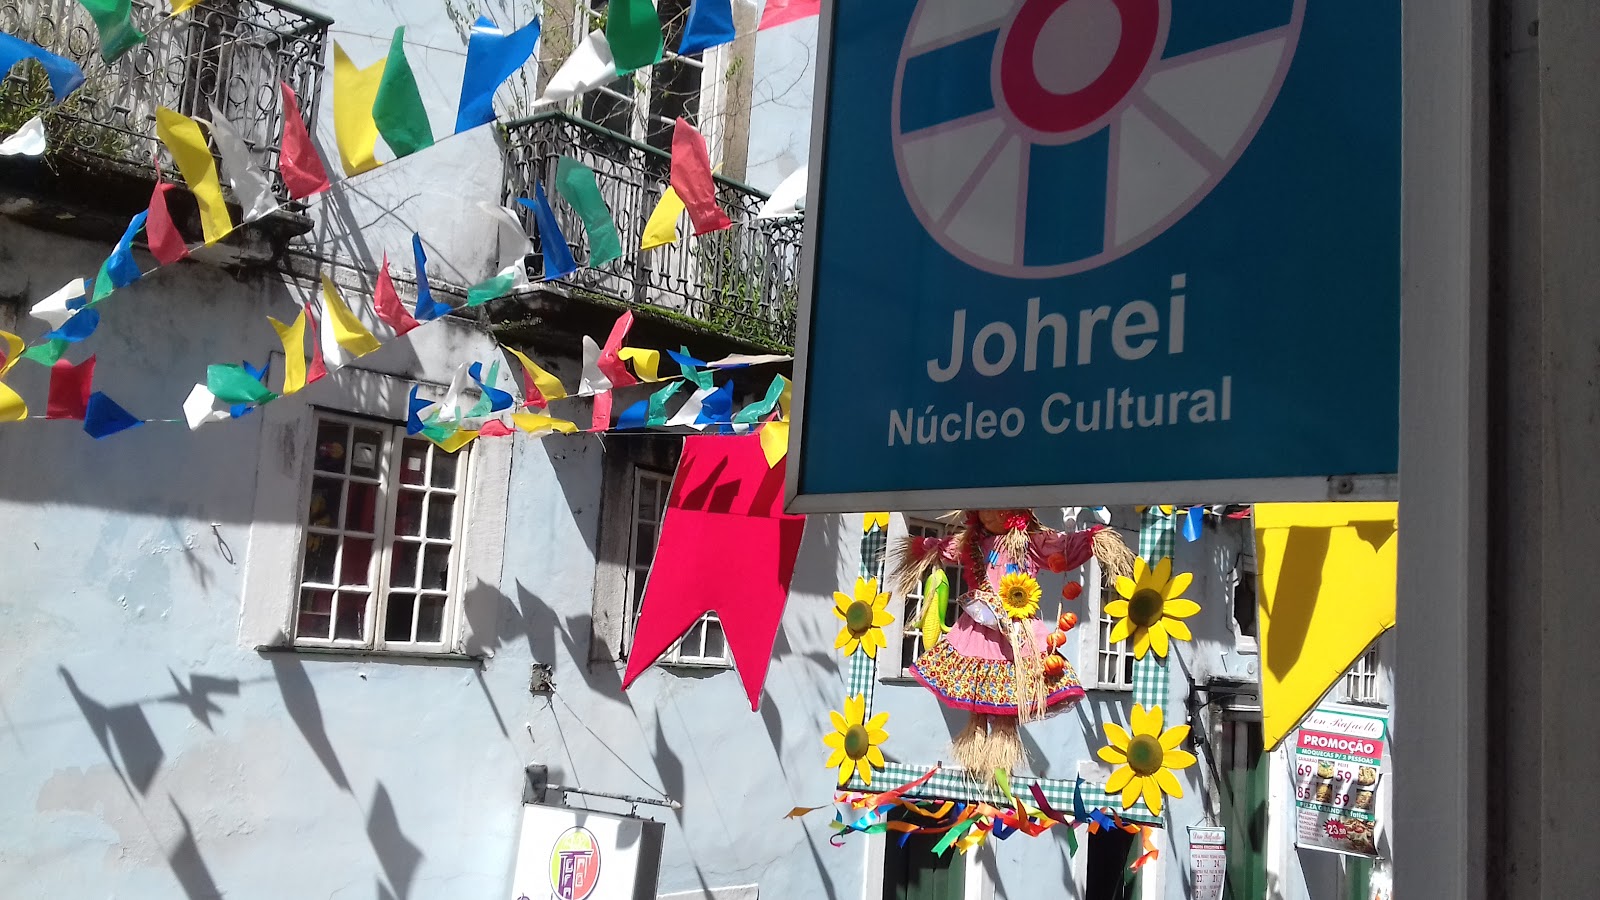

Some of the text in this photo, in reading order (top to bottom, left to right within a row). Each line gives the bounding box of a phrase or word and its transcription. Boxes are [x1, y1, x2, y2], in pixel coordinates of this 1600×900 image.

[927, 273, 1187, 383] Johrei
[888, 375, 1232, 447] Núcleo Cultural
[1303, 734, 1375, 754] PROMOÇÃO
[1301, 749, 1334, 759] MOQUECAS
[1348, 755, 1374, 765] PESSOAS
[1297, 764, 1352, 783] 69 59
[1297, 786, 1350, 806] 85 59
[1300, 801, 1317, 810] PIZZA
